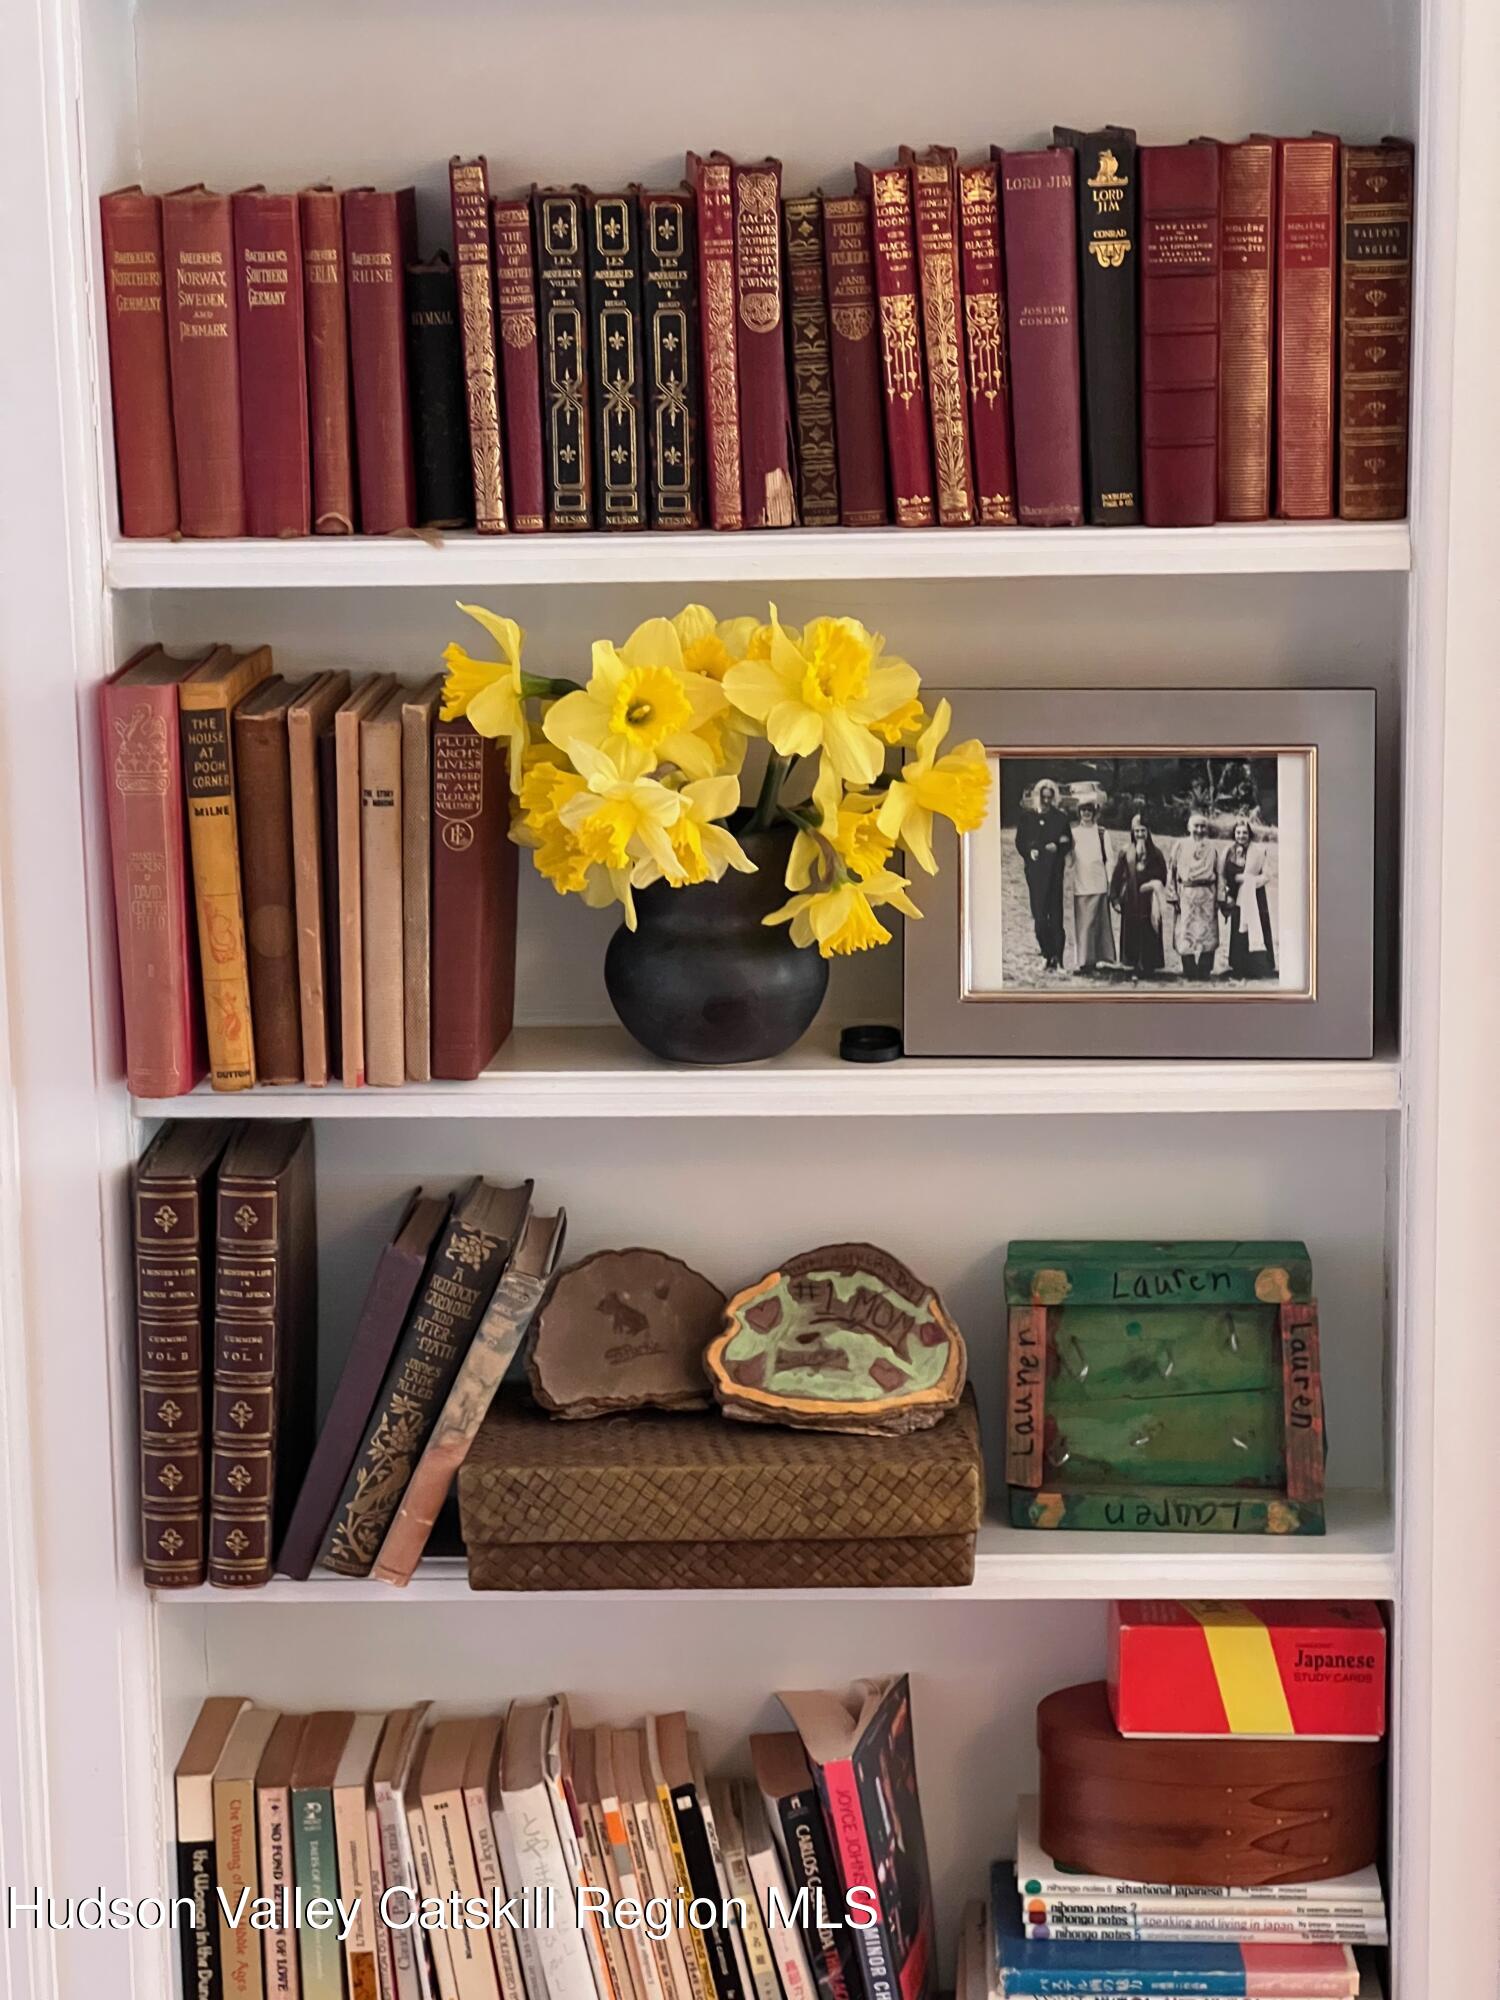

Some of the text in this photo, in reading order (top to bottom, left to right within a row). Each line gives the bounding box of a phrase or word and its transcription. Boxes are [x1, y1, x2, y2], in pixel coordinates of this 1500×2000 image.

[1006, 175, 1072, 190] LORD JIM
[704, 194, 731, 206] KIM
[1093, 190, 1123, 201] LORD
[876, 206, 911, 216] LORNA
[963, 205, 996, 215] LORNA
[1097, 201, 1121, 214] JIM
[456, 219, 487, 229] WORK
[833, 223, 864, 236] PRIDE
[502, 231, 522, 241] THE
[1094, 229, 1126, 238] CONRAD
[500, 243, 527, 255] VICAR
[839, 239, 861, 249] AND
[508, 256, 519, 266] OF
[554, 256, 572, 265] LES
[606, 257, 624, 266] LES
[660, 259, 678, 267] LES
[176, 268, 227, 288] NORWAY,
[246, 266, 288, 287] SOUTHERN
[352, 269, 393, 283] RHINE
[839, 276, 866, 286] JANE
[116, 294, 161, 316] GERMANY
[177, 291, 227, 309] SWEDEN,
[248, 288, 287, 311] GERMANY
[193, 311, 214, 319] AND
[1021, 305, 1066, 315] JOSEPH
[412, 312, 453, 325] HYMNAL
[1020, 317, 1068, 326] CONRAD
[179, 321, 228, 342] DENMARK
[554, 515, 588, 525] NELSON
[606, 516, 640, 525] NELSON
[658, 516, 692, 526] NELSON
[191, 717, 216, 730] THE
[188, 731, 225, 744] HOUSE
[200, 747, 214, 758] AT
[194, 761, 226, 773] POOH
[192, 775, 229, 789] CORNER
[437, 772, 480, 780] REVISED
[437, 792, 480, 801] CLOUGH
[194, 805, 230, 817] MILNE
[436, 801, 474, 810] VOLUME
[215, 1069, 251, 1080] DUTTON
[452, 1266, 464, 1283] A
[431, 1274, 481, 1301] KENTUCKY
[1112, 1268, 1231, 1299] Lauren
[424, 1290, 472, 1320] CARDINAL
[431, 1311, 453, 1327] AND
[793, 1280, 915, 1348] #1 MOM
[404, 1369, 433, 1386] LANE
[1290, 1322, 1313, 1429] Lauren
[396, 1378, 434, 1400] ALLEN
[1294, 1648, 1375, 1672] Japanese
[1294, 1673, 1373, 1683] STUDY CARDS
[229, 1799, 242, 1820] The
[835, 1788, 859, 1833] JOYCE
[383, 1823, 398, 1852] midi
[227, 1824, 245, 1870] Waning
[795, 1823, 819, 1877] CARLOS
[309, 1840, 320, 1868] TALES
[1046, 1883, 1081, 1893] nihongo
[1083, 1885, 1105, 1893] notes
[1116, 1882, 1171, 1895] situational
[1175, 1885, 1222, 1897] japanese
[193, 1849, 212, 1966] the Woman in the
[271, 1823, 289, 1991] NO FOND OF LOVE
[1051, 1902, 1094, 1916] nihongo
[1097, 1905, 1127, 1913] notes
[1052, 1913, 1094, 1928] nihongo
[1097, 1915, 1128, 1925] notes
[1143, 1918, 1192, 1929] speaking
[1195, 1918, 1215, 1928] and
[1218, 1919, 1247, 1932] living
[1250, 1920, 1261, 1930] in
[1264, 1920, 1294, 1932] japan
[1056, 1927, 1097, 1941] nihongo
[1101, 1930, 1131, 1939] notes
[863, 1925, 887, 1978] MINOR
[231, 1960, 249, 1991] Ages
